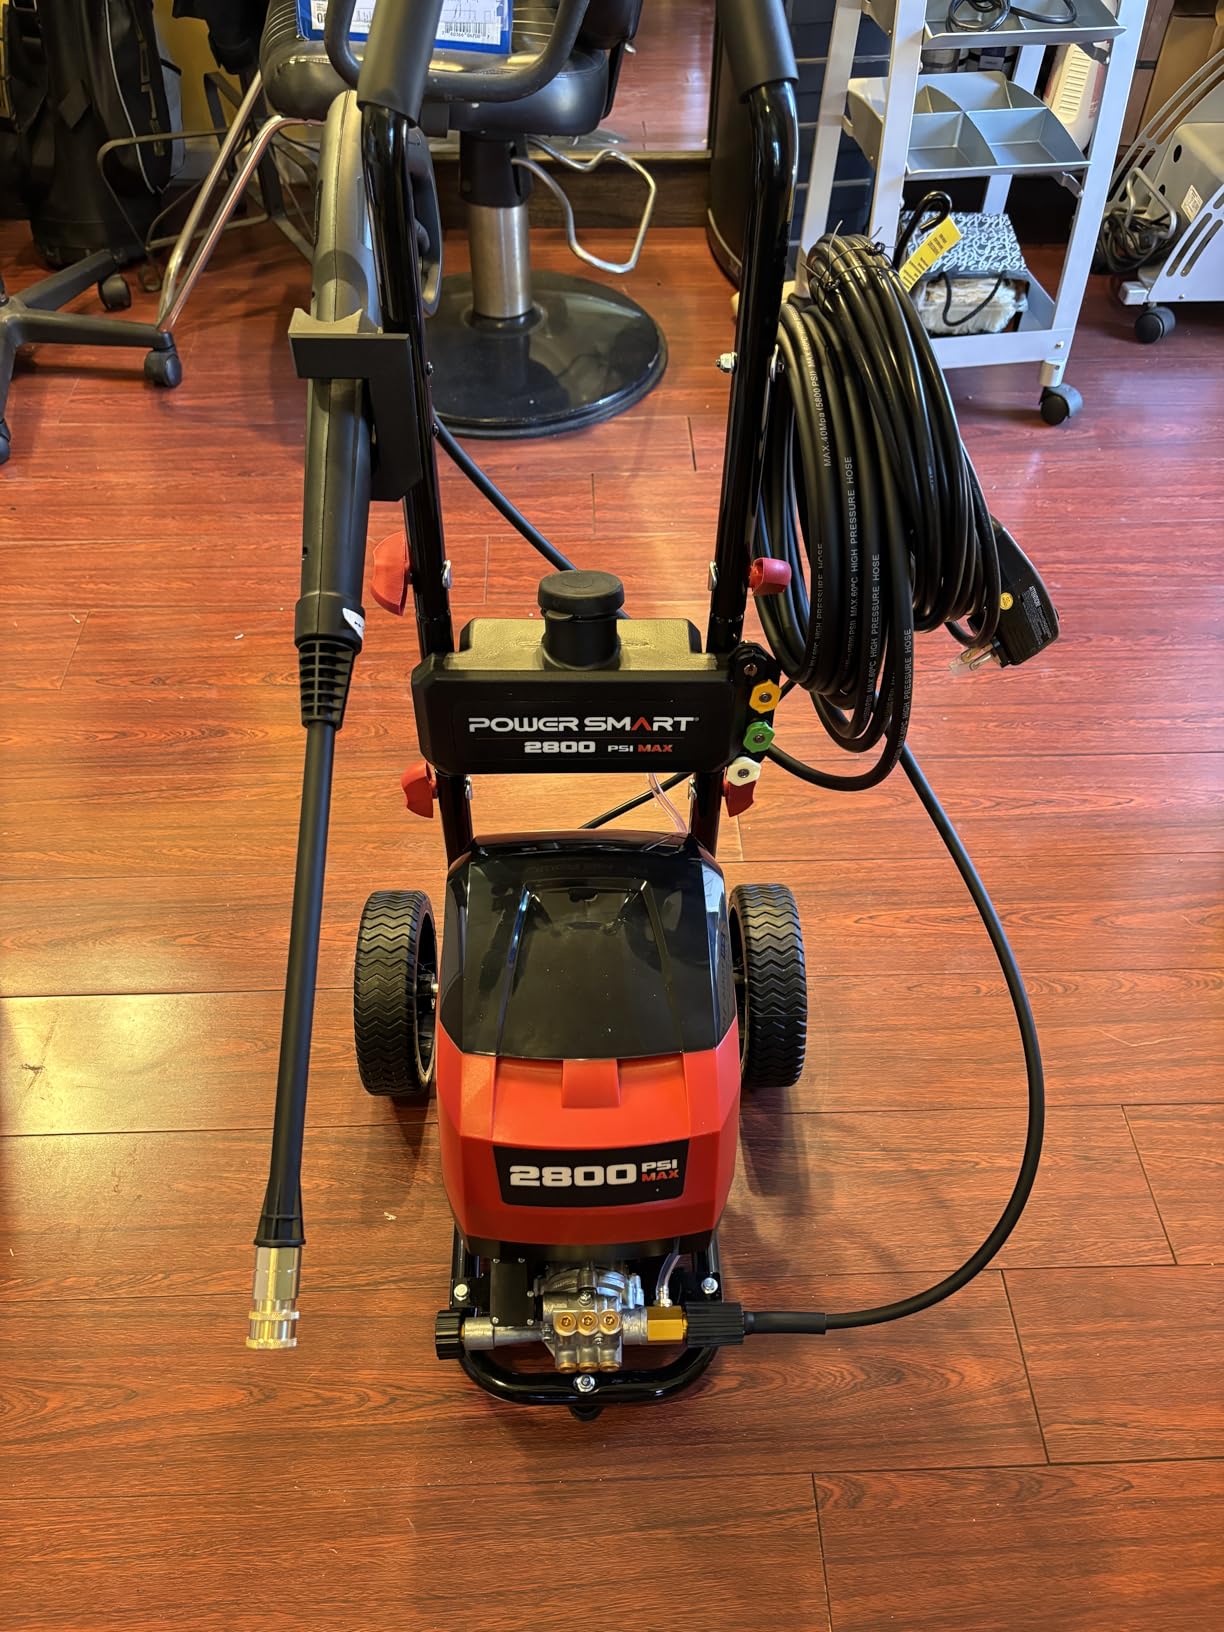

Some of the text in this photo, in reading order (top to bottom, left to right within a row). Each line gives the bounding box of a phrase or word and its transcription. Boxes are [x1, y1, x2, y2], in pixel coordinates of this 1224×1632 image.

[844, 456, 855, 484] HOSE
[847, 489, 858, 544] PRESSURE
[850, 549, 859, 573] HIGH
[872, 553, 880, 581] HOSE
[871, 585, 880, 635] PRESSURE
[870, 638, 879, 658] HIGH
[903, 628, 912, 654] HOSE
[903, 657, 912, 701] PRESSURE
[468, 717, 579, 733] POWER
[524, 741, 673, 753] 2800 PSI MAX
[509, 1158, 678, 1188] 2800 PSI
[641, 1169, 680, 1183] MAX
